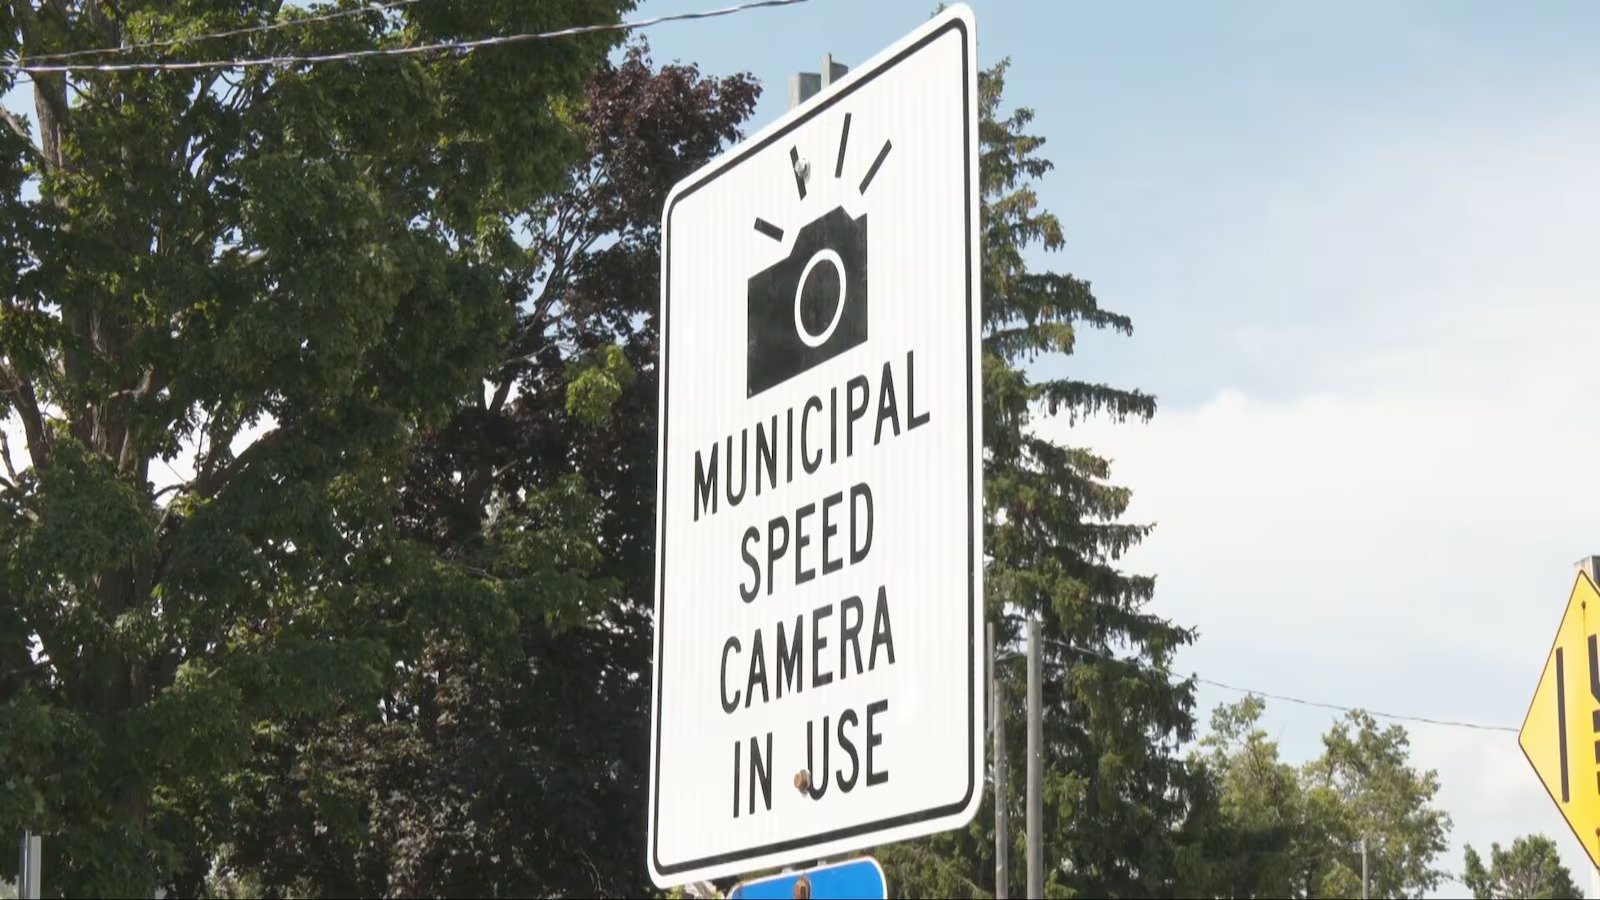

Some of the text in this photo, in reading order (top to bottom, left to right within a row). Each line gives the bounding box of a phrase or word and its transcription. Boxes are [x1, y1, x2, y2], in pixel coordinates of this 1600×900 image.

[693, 350, 930, 522] MUNICIPAL
[739, 483, 874, 603] SPEED
[720, 586, 895, 714] CAMERA
[733, 699, 889, 818] IN USE
